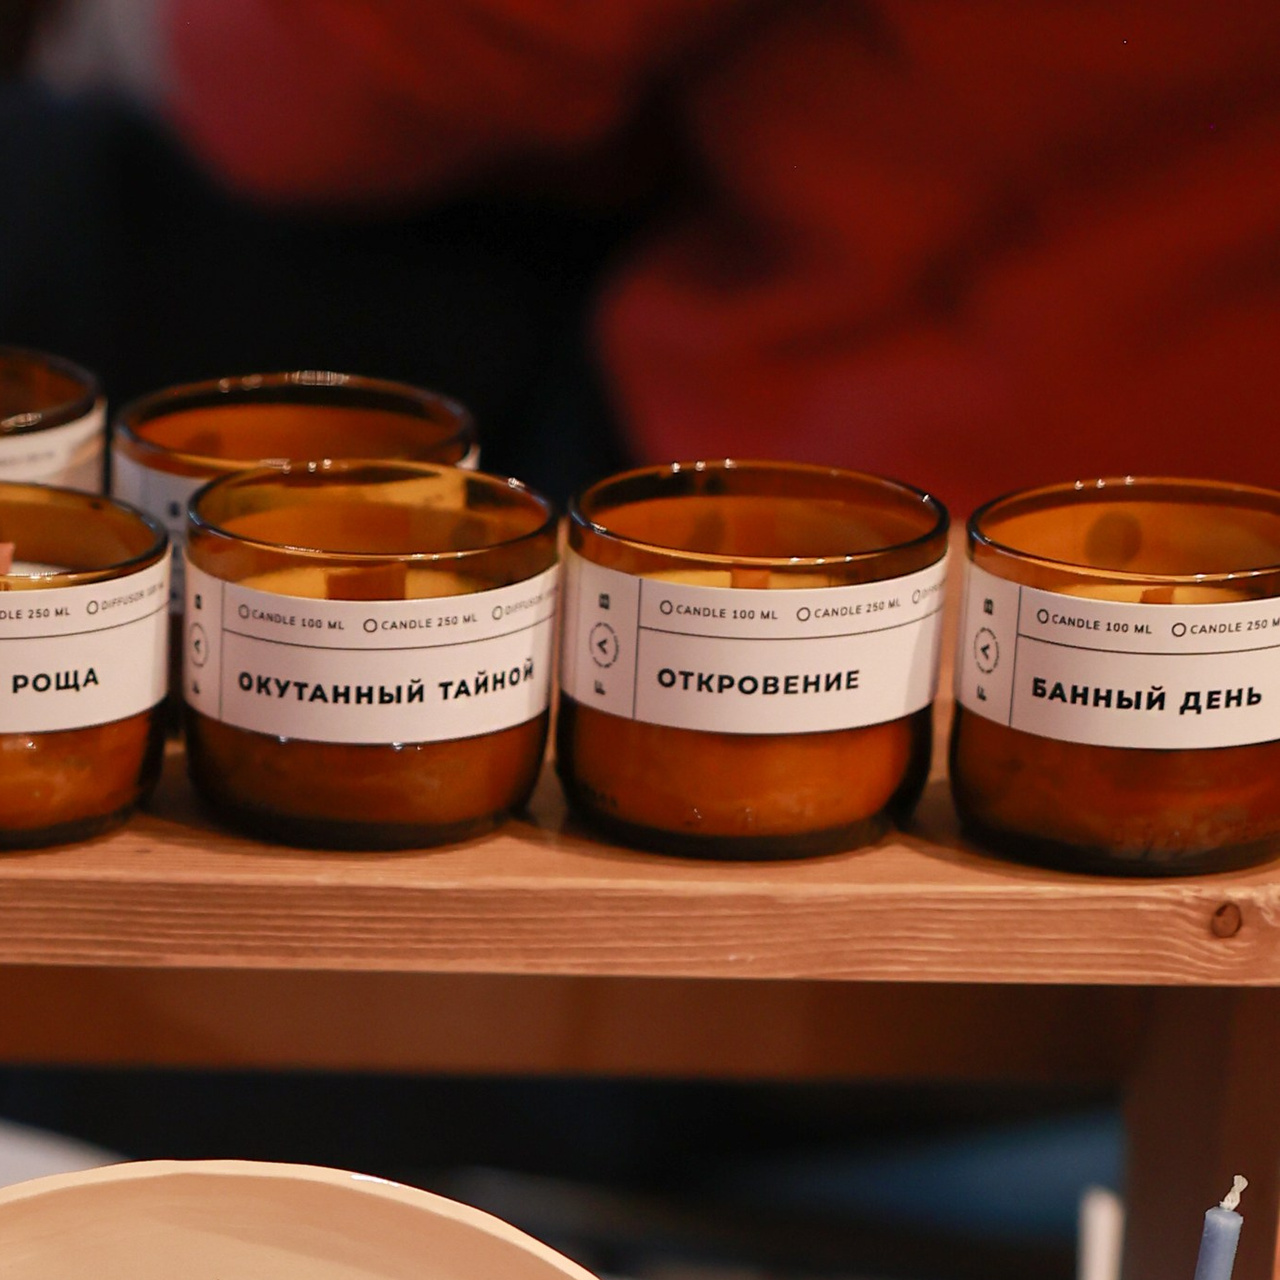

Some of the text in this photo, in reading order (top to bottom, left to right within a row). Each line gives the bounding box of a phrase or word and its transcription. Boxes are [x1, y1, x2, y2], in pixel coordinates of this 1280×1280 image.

[28, 608, 50, 619] 250
[54, 606, 71, 617] ML
[676, 604, 778, 620] CANDLE 100 ML
[814, 604, 862, 619] CANDLE
[888, 598, 901, 609] ML
[252, 609, 345, 630] CANDLE 100 ML
[381, 613, 478, 631] CANDLE 250 ML
[1051, 613, 1153, 635] CANDLE 100 ML
[1190, 622, 1242, 635] CANDLE
[1247, 619, 1269, 631] 250
[12, 667, 100, 694] РОЩА
[239, 658, 535, 705] ОКУТАННЫЙ ТАЙНОЙ
[657, 667, 860, 695] ОТКРОВЕНИЕ
[1031, 677, 1263, 714] БАННЫЙ ДЕНЬ
